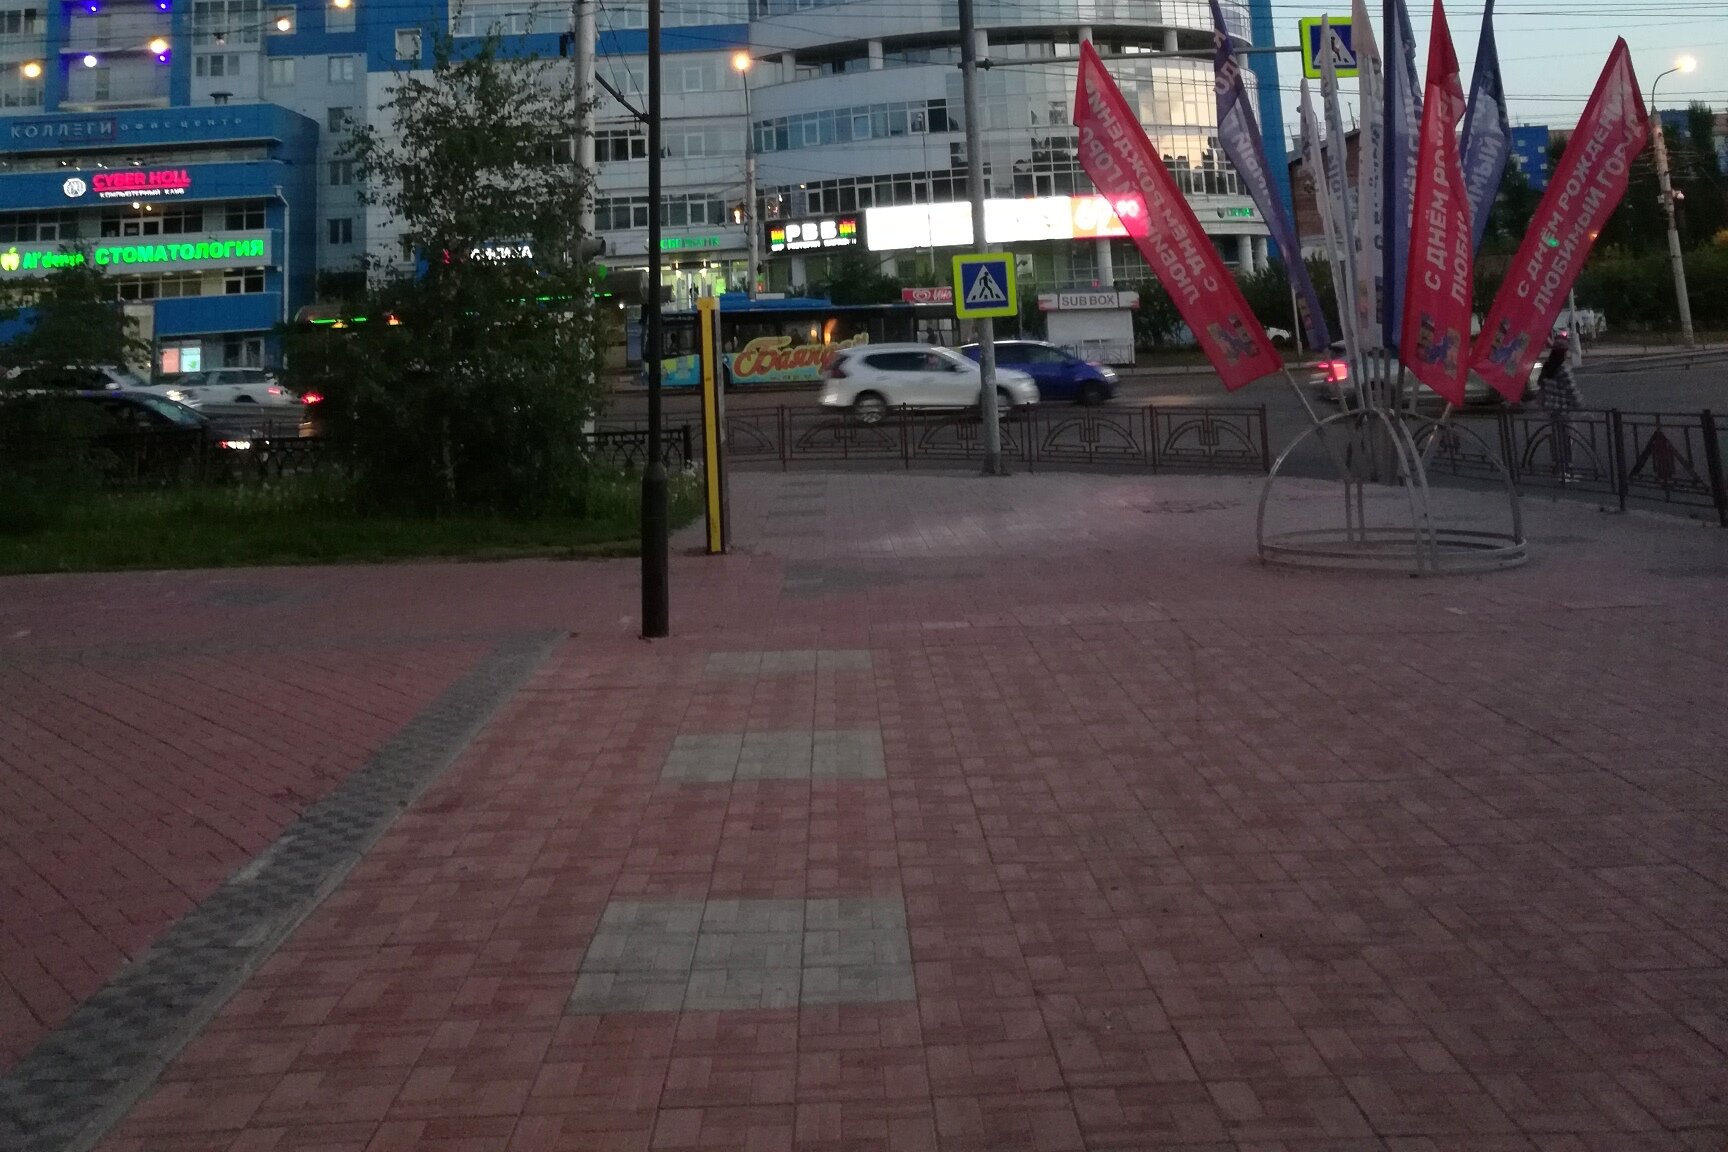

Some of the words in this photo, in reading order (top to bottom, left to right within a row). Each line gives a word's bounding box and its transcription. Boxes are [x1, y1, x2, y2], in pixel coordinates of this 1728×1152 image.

[95, 239, 264, 265] СТОМАТОЛОГИЯ
[1426, 190, 1449, 272] ДНЁМ
[1533, 181, 1607, 316] ЛЮБИМЫЙ
[1061, 295, 1088, 306] SUB
[1089, 294, 1115, 306] BOX
